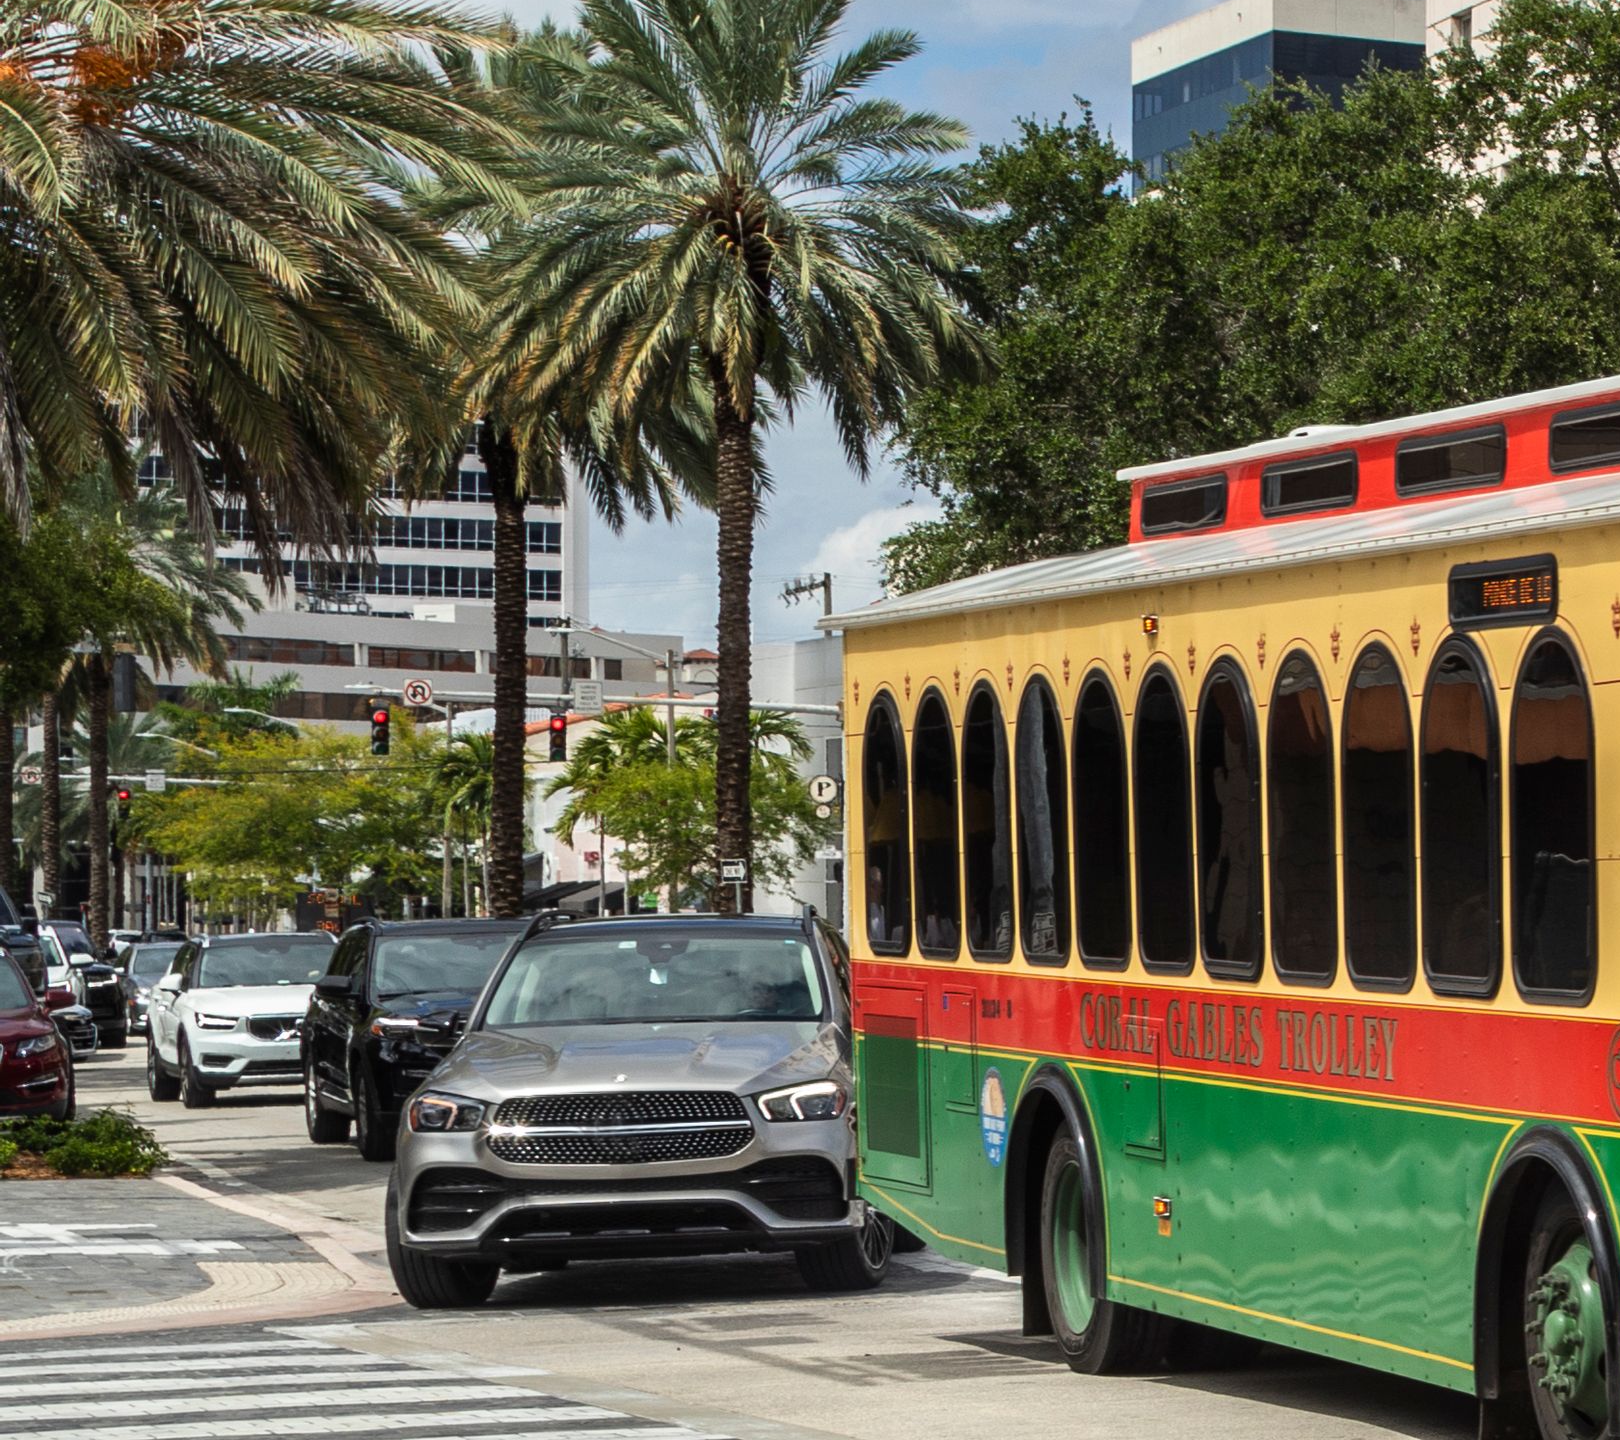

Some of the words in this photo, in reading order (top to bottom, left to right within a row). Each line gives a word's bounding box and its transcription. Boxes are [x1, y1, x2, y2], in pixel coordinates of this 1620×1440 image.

[817, 781, 832, 797] P
[1080, 992, 1155, 1055] CORAL
[1166, 999, 1264, 1067] GABLES
[1277, 1010, 1400, 1082] TROLLEY
